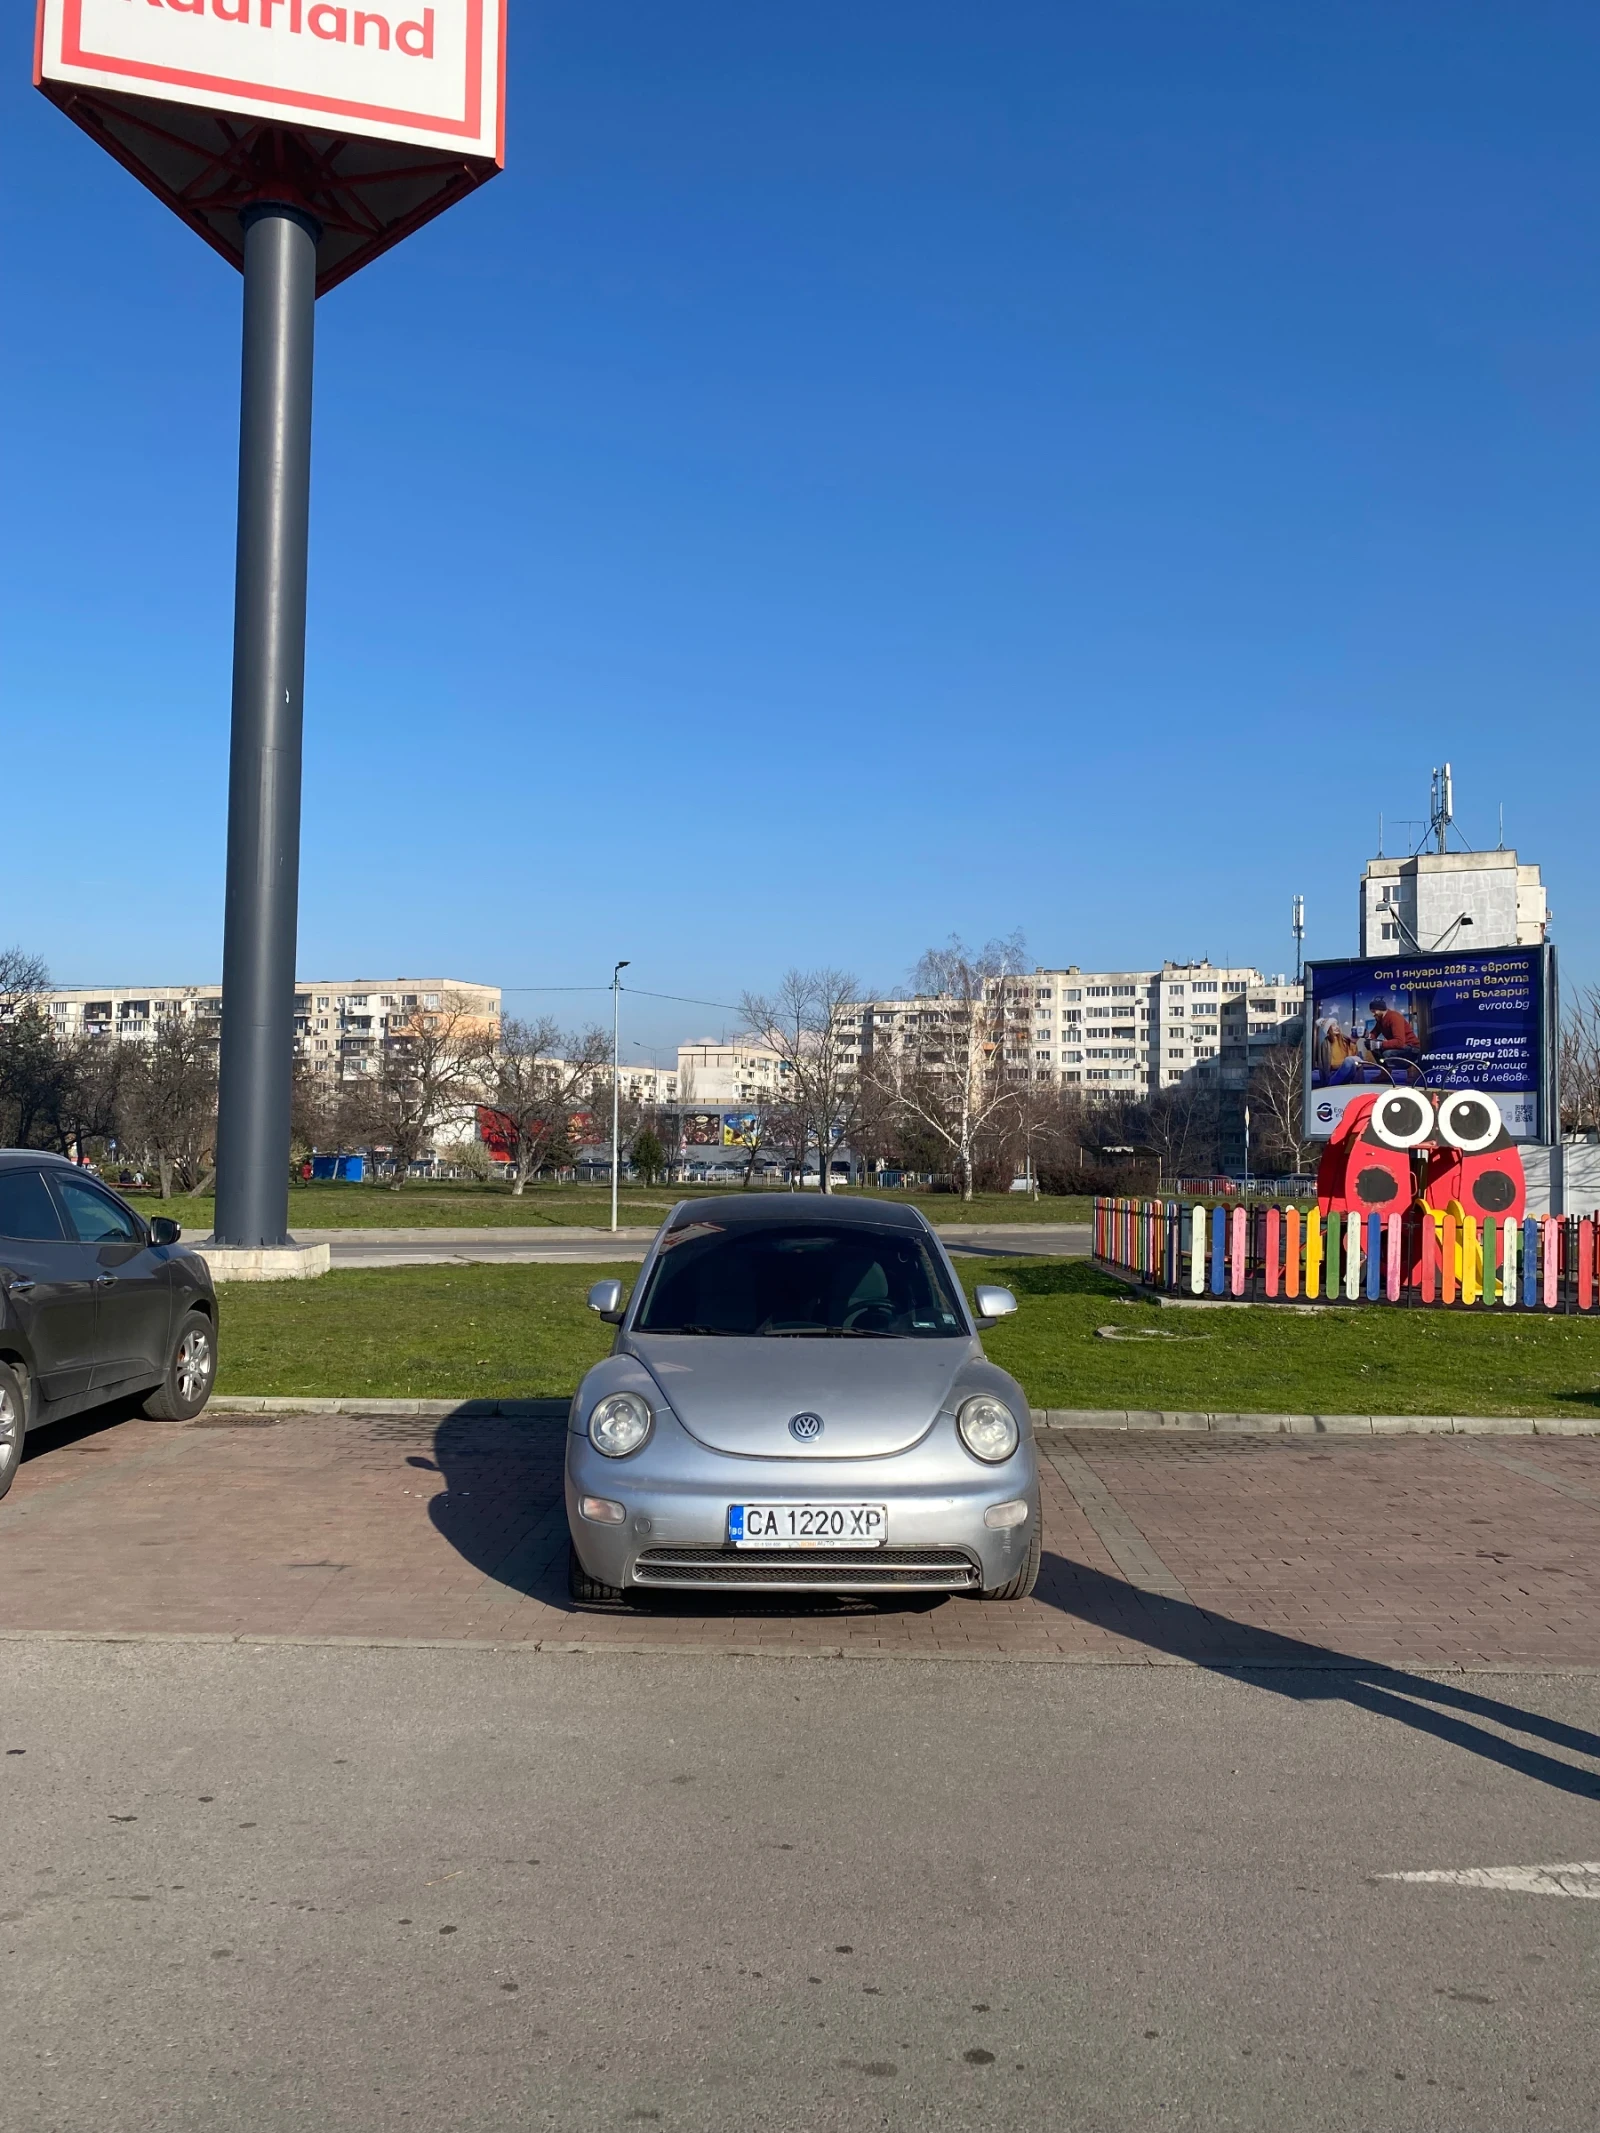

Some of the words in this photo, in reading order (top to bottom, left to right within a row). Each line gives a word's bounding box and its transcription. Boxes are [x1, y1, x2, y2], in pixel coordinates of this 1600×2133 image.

[124, 0, 434, 59] ufland
[1374, 970, 1393, 980] От
[1396, 969, 1400, 978] 1
[1402, 968, 1442, 980] януари
[1444, 964, 1467, 974] 2026
[1469, 965, 1478, 973] г.
[1481, 961, 1529, 973] еврото
[1390, 983, 1397, 991] е
[1399, 977, 1481, 991] официалната
[1483, 974, 1529, 986] валута
[1455, 990, 1470, 1000] на
[1472, 986, 1529, 999] България
[1478, 999, 1530, 1011] evroto.bg
[1465, 1037, 1492, 1048] През
[1494, 1036, 1527, 1046] целия
[1421, 1052, 1454, 1061] месец
[1456, 1051, 1495, 1061] януари
[1497, 1048, 1519, 1058] 2026
[1521, 1050, 1530, 1058] г.
[1460, 1063, 1475, 1073] да
[1476, 1063, 1489, 1071] се
[1491, 1062, 1528, 1071] плаща
[1427, 1076, 1434, 1084] и
[1435, 1074, 1442, 1084] в
[1473, 1075, 1480, 1083] и
[1482, 1073, 1489, 1083] в
[1490, 1072, 1530, 1082] левове.
[747, 1510, 778, 1535] CA
[787, 1510, 844, 1535] 1220
[850, 1509, 881, 1535] XP
[731, 1527, 743, 1535] BG
